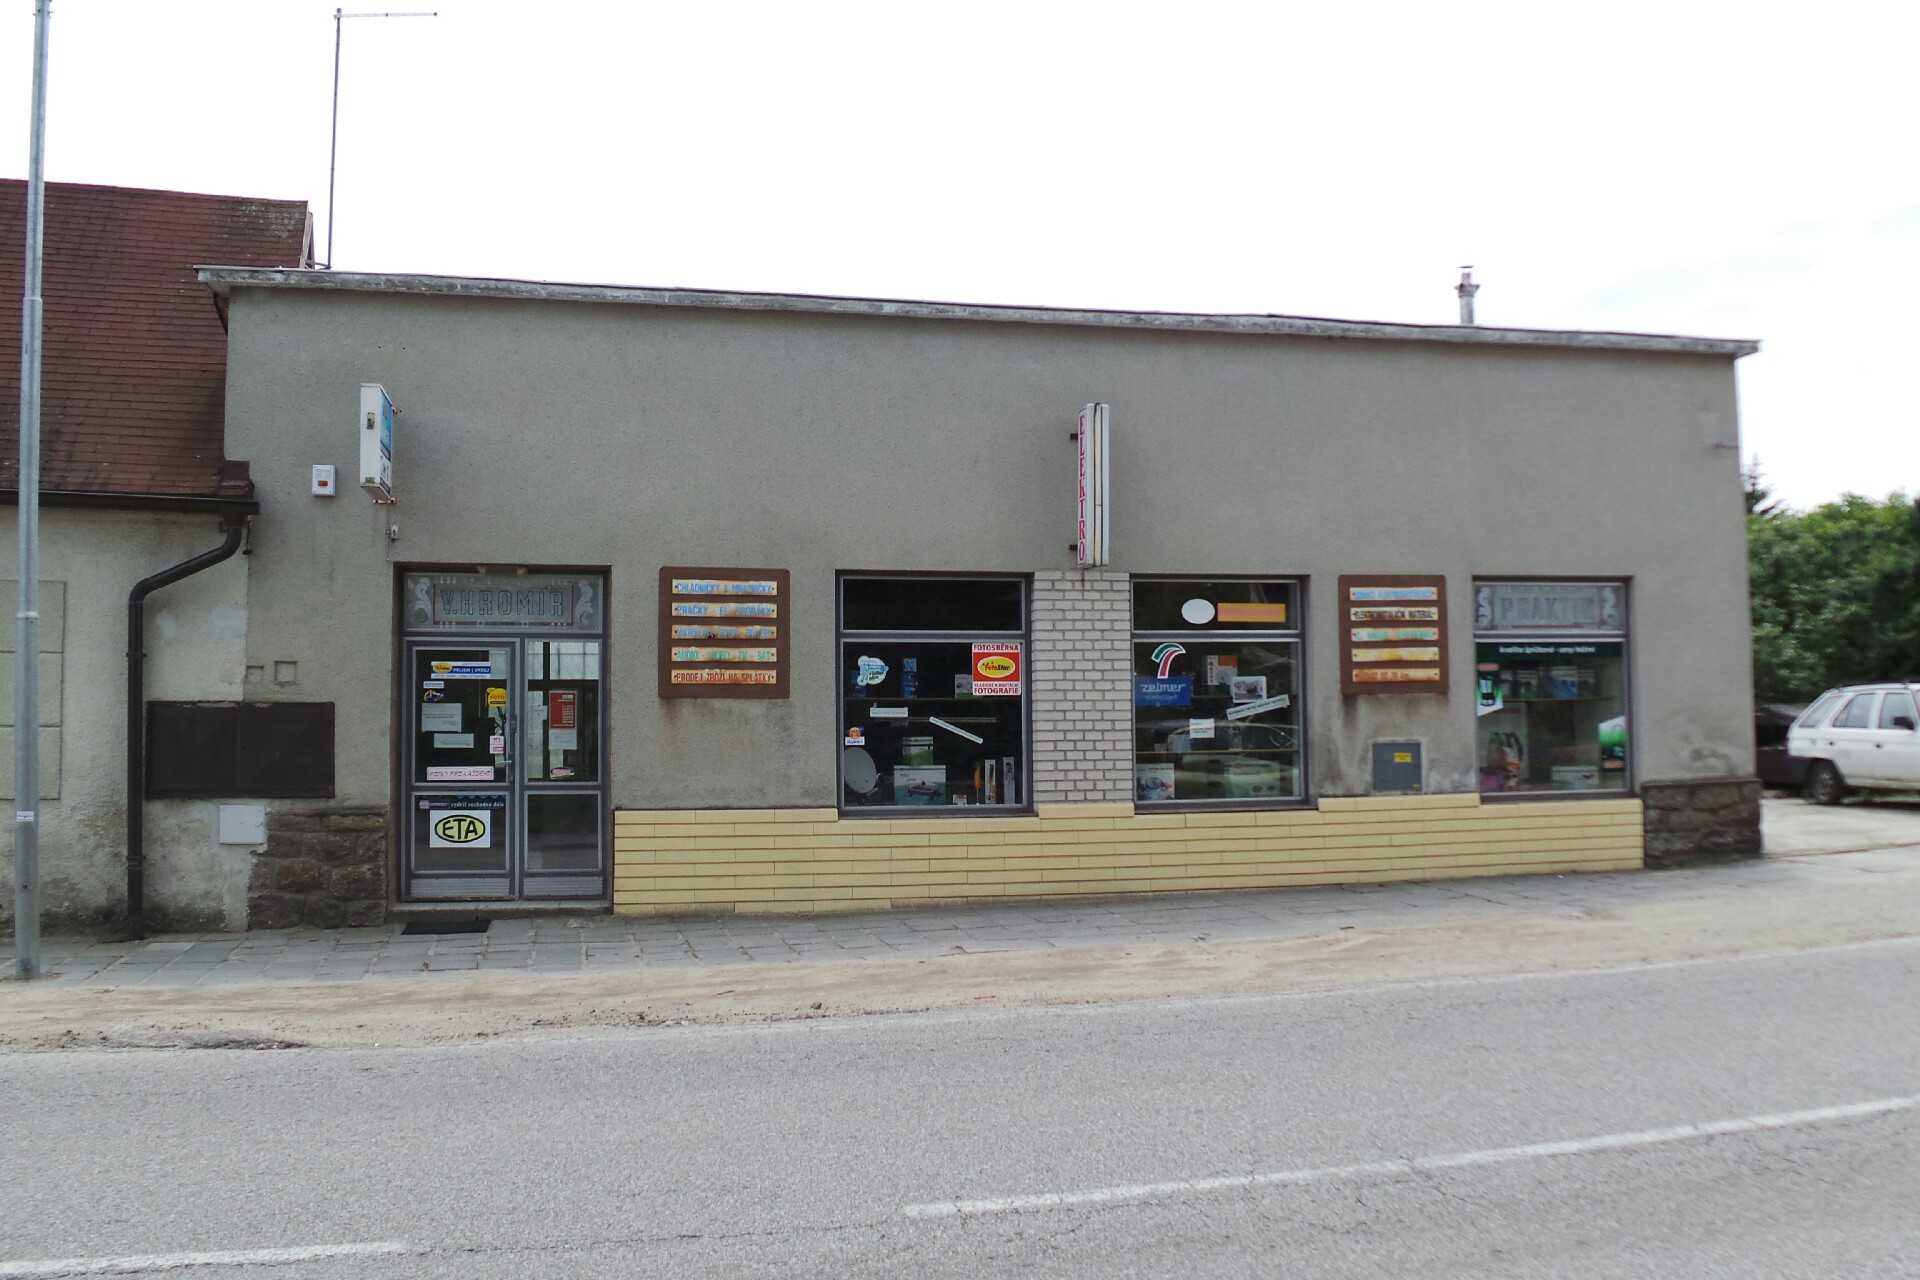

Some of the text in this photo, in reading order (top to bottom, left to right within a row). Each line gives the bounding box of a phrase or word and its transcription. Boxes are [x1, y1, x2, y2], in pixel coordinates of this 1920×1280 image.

[973, 643, 1019, 651] FOTOSBĚRNA
[676, 672, 703, 682] PRODEJ
[706, 670, 725, 682] ZBOŽÍ
[741, 671, 772, 682] SPLÁTKY
[974, 687, 1019, 695] FOTOGRAFIE
[1139, 682, 1187, 693] zelmer
[442, 818, 479, 841] ETA
